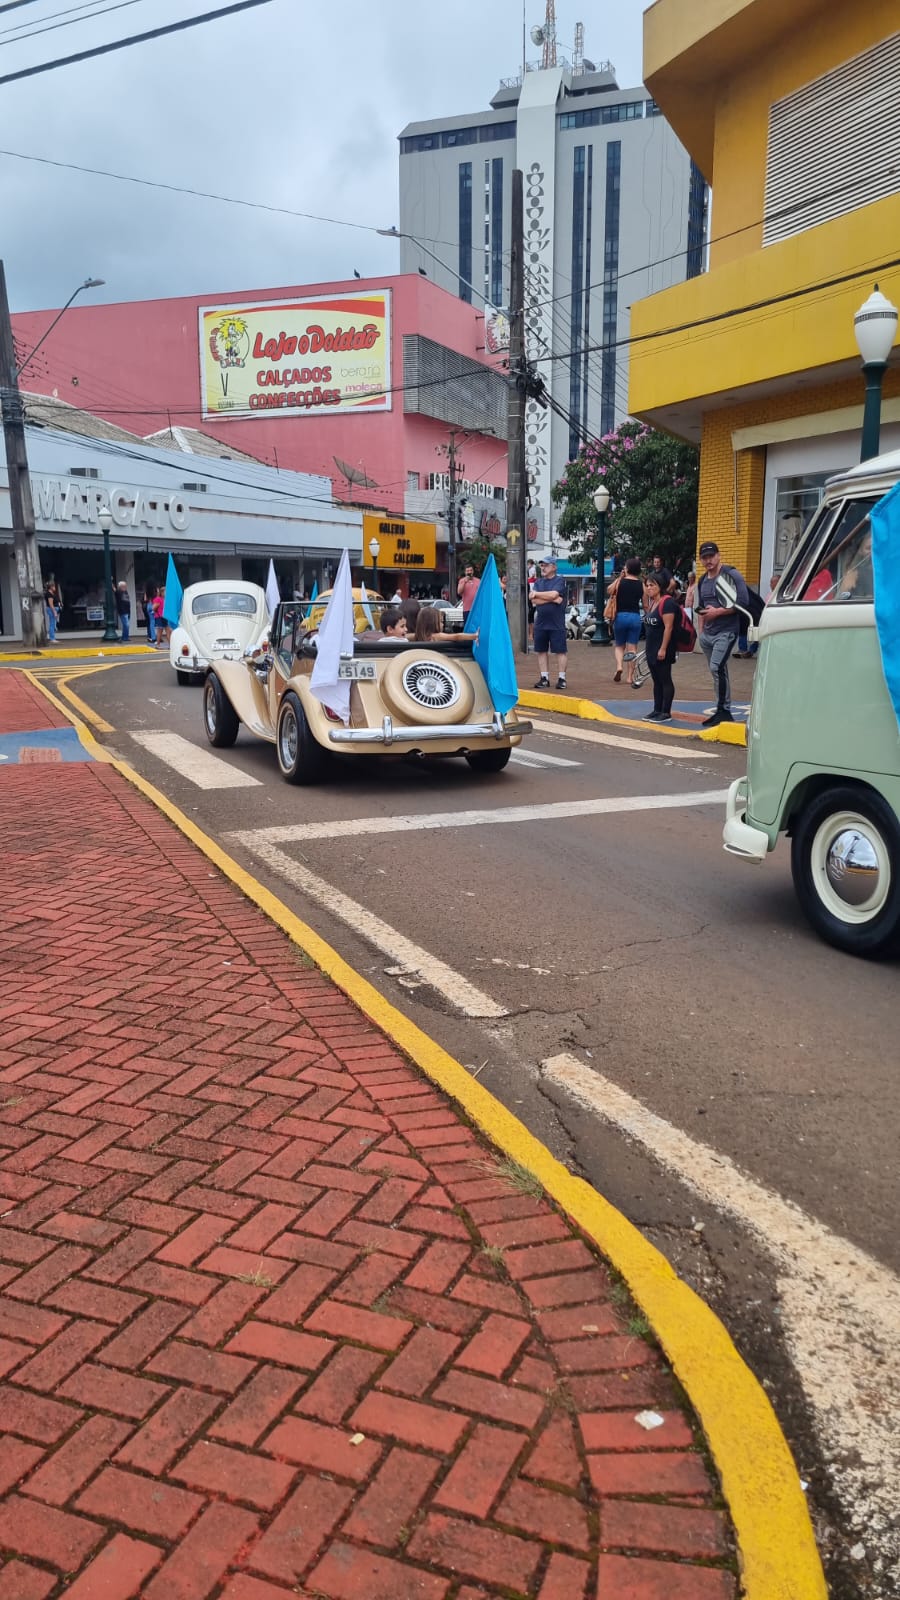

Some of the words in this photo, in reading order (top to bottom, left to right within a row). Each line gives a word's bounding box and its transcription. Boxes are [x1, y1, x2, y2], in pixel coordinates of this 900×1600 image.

[252, 331, 298, 361] Loja
[306, 324, 380, 353] Doidão
[256, 366, 332, 388] CALÇADOS
[248, 386, 341, 409] CONFECÇÕES
[31, 479, 192, 531] MARCATO
[338, 667, 375, 678] -5149
